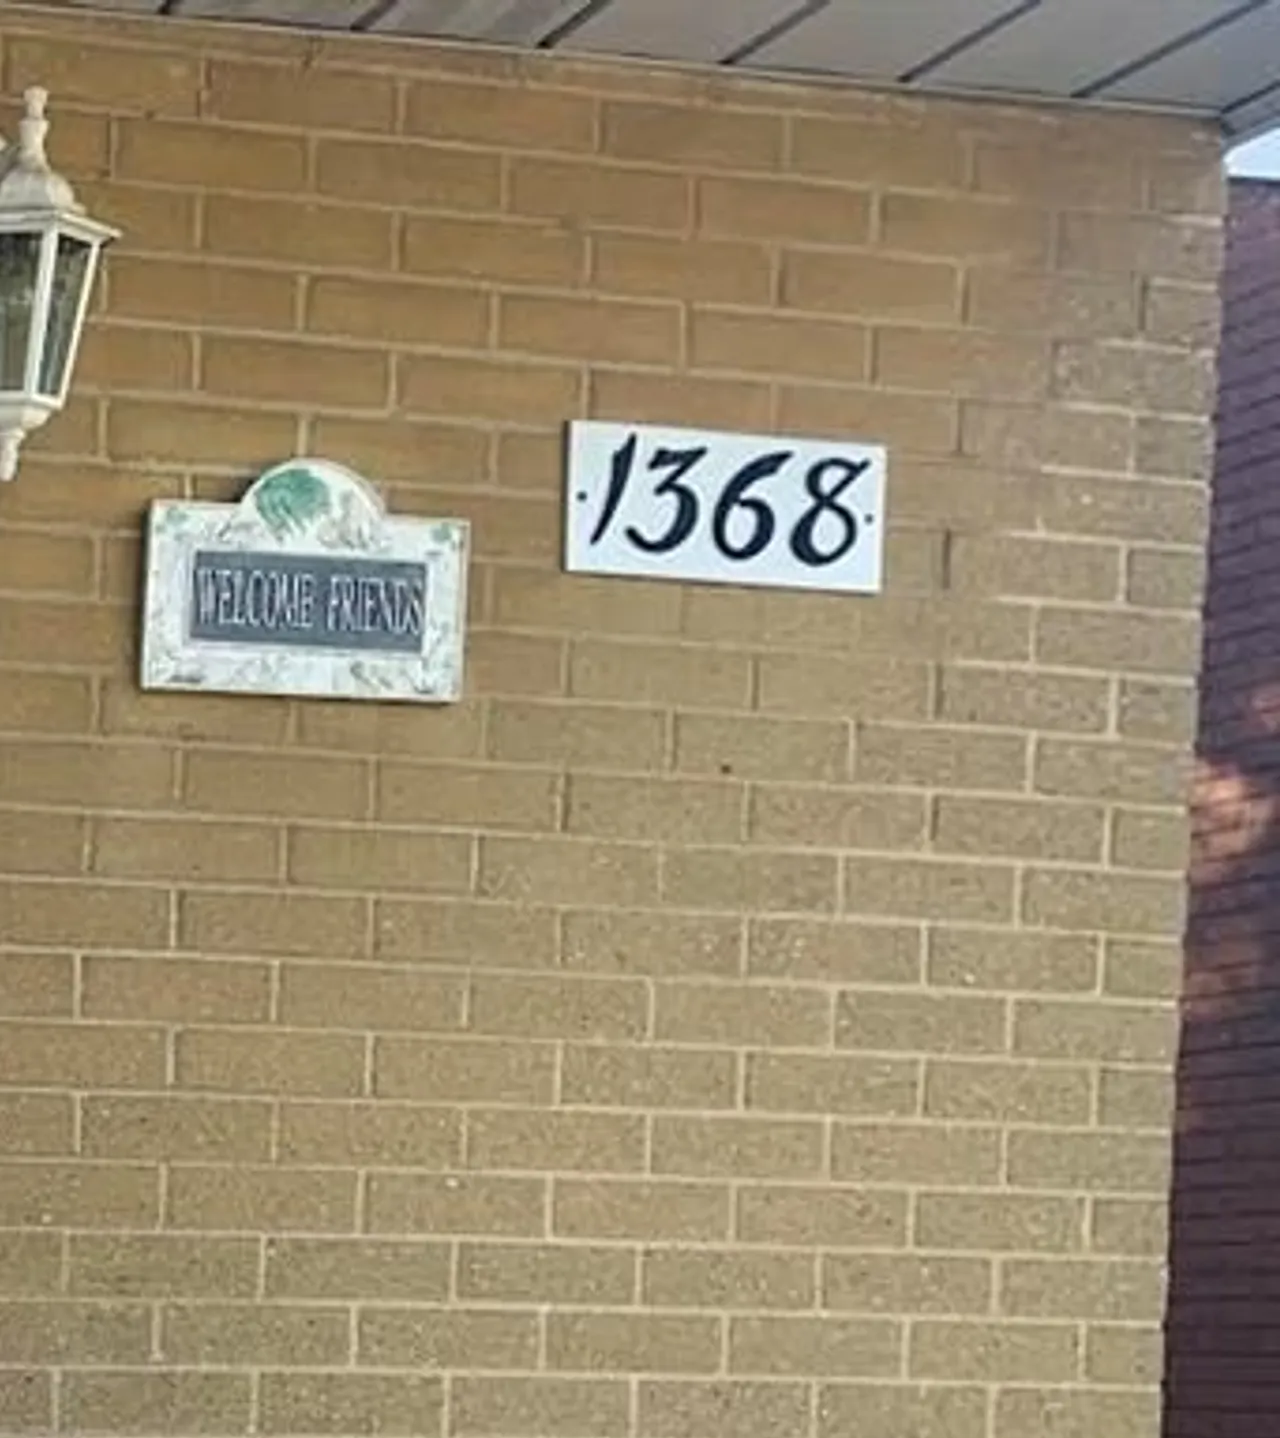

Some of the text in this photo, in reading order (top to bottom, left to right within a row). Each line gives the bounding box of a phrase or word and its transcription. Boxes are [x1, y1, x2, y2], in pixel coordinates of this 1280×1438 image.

[590, 433, 872, 567] 1368
[196, 567, 426, 636] WELCOME FRIENDS
